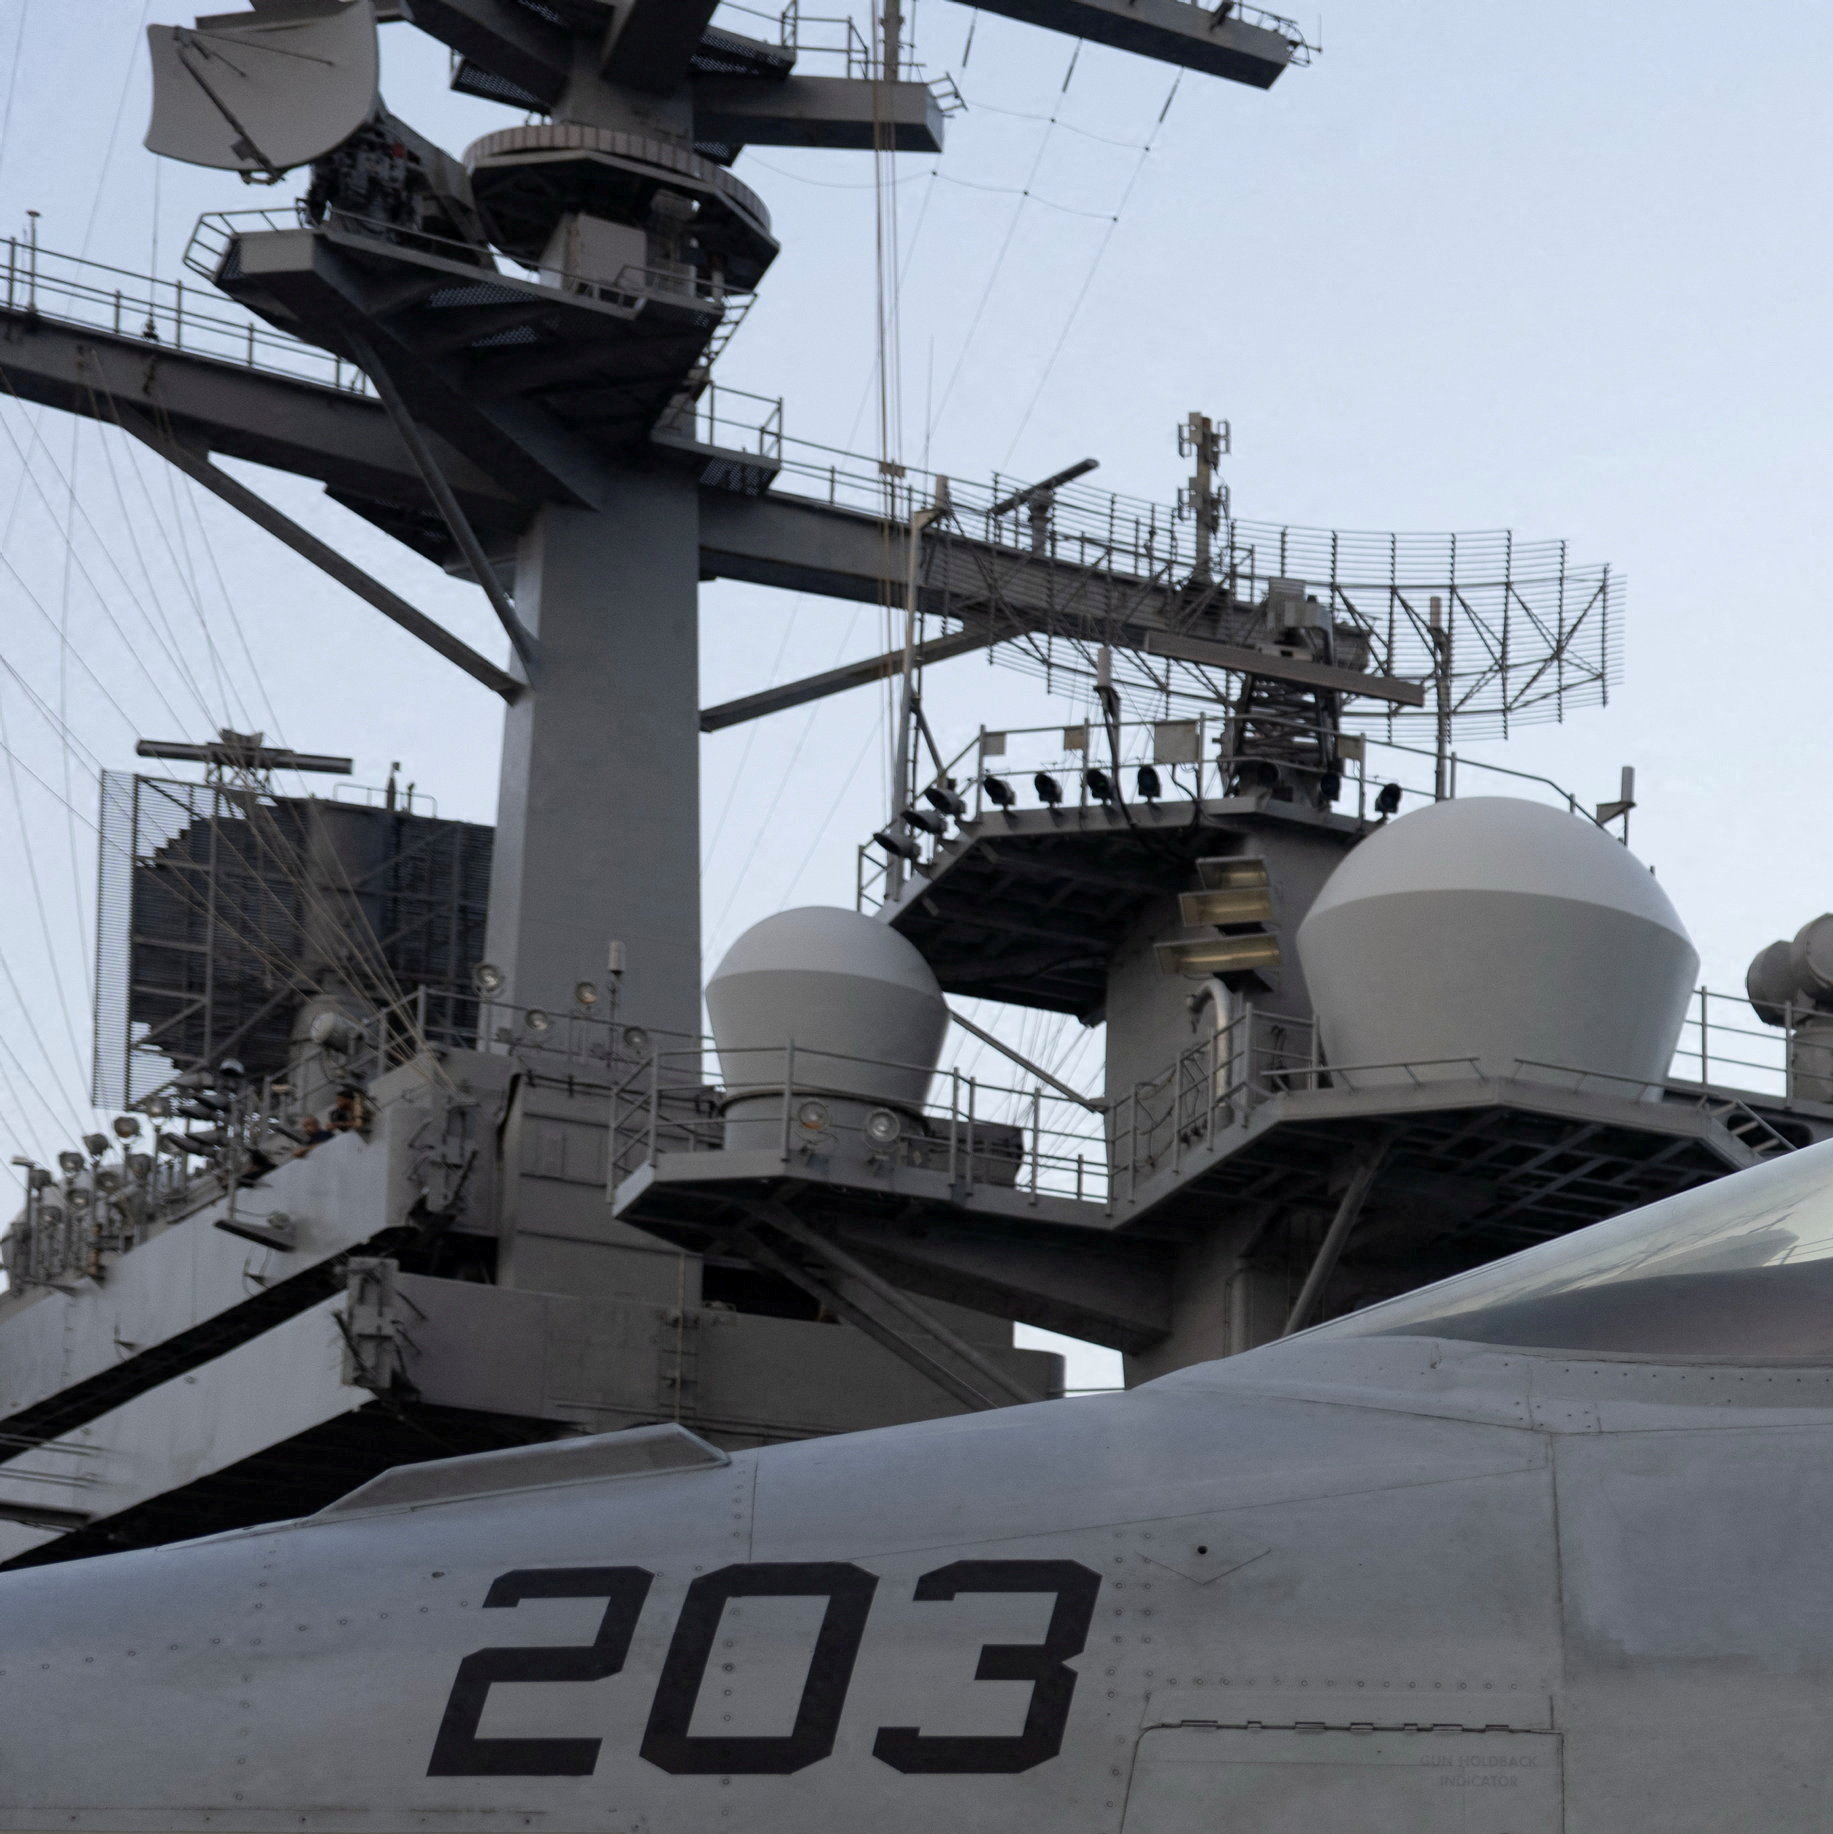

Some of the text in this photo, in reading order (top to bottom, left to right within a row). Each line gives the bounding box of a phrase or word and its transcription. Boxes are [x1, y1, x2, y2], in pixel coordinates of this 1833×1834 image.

[426, 1559, 1103, 1777] 203
[1459, 1754, 1537, 1767] HOLDBACK
[1440, 1775, 1518, 1787] INDICATOR
